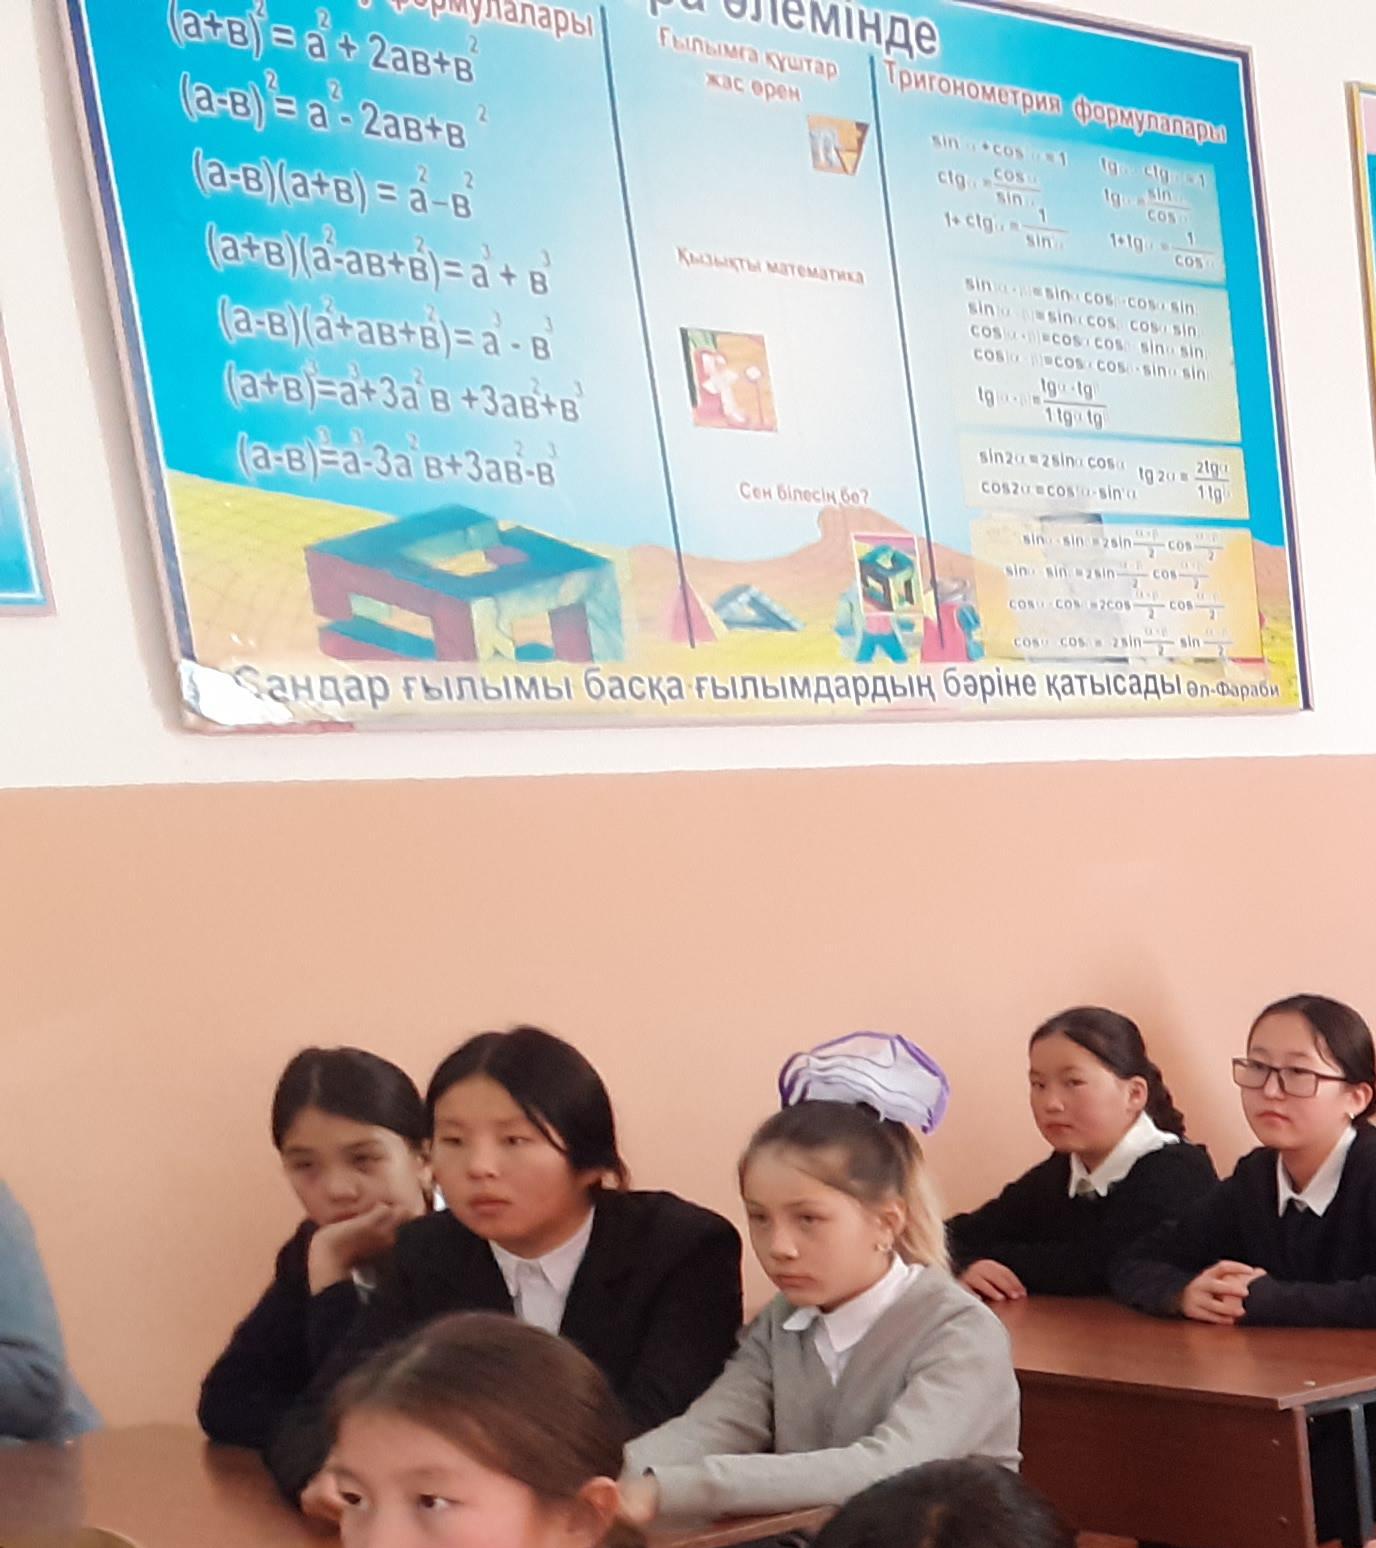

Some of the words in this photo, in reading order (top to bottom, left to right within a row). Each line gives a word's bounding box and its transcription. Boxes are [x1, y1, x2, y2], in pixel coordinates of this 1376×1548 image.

[706, 71, 744, 93] жас
[884, 59, 1060, 114] Тригонометрия
[1074, 95, 1226, 143] формулалары
[766, 261, 865, 284] математика
[739, 482, 772, 500] Сен
[403, 673, 573, 701] ғылымы
[584, 669, 685, 707] басқа
[696, 671, 936, 707] ғылымдардың
[943, 668, 1037, 704] бәріне
[1046, 671, 1181, 702] қатысады
